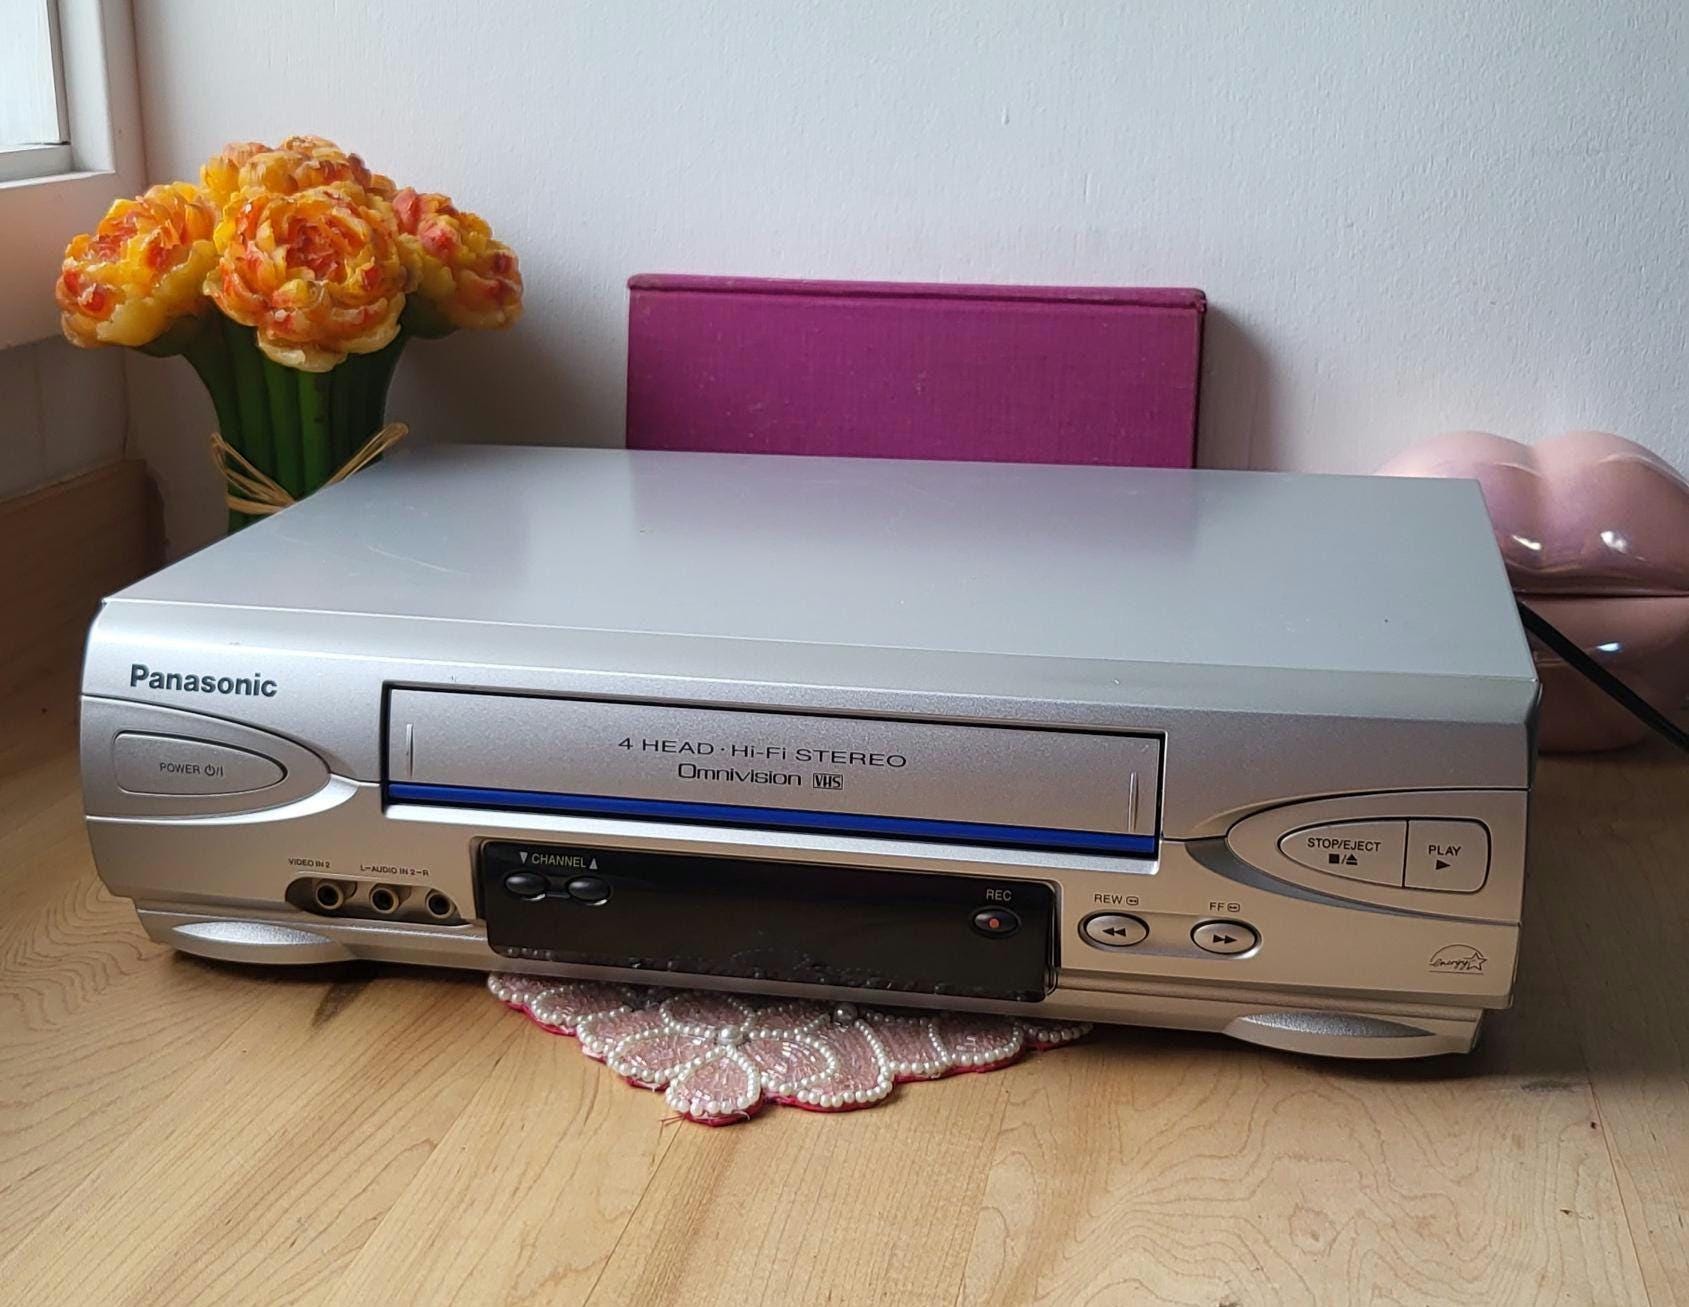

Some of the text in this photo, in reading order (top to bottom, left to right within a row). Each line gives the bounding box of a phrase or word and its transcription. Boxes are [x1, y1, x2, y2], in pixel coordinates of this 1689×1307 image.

[130, 663, 278, 698] Panasonic
[618, 737, 633, 750] 4
[642, 738, 714, 755] HEAD
[795, 748, 907, 767] STEREO
[159, 762, 201, 775] POWER
[678, 763, 843, 791] Omnivision VHS
[1307, 837, 1381, 852] STOP/EJECT
[1428, 845, 1462, 857] PLAY
[288, 858, 314, 868] VIDEO
[315, 860, 324, 868] IN
[531, 853, 586, 868] CHANNEL
[400, 866, 409, 875] IN
[986, 889, 1012, 902] REC
[1094, 894, 1123, 906] REW
[1209, 902, 1225, 914] FF
